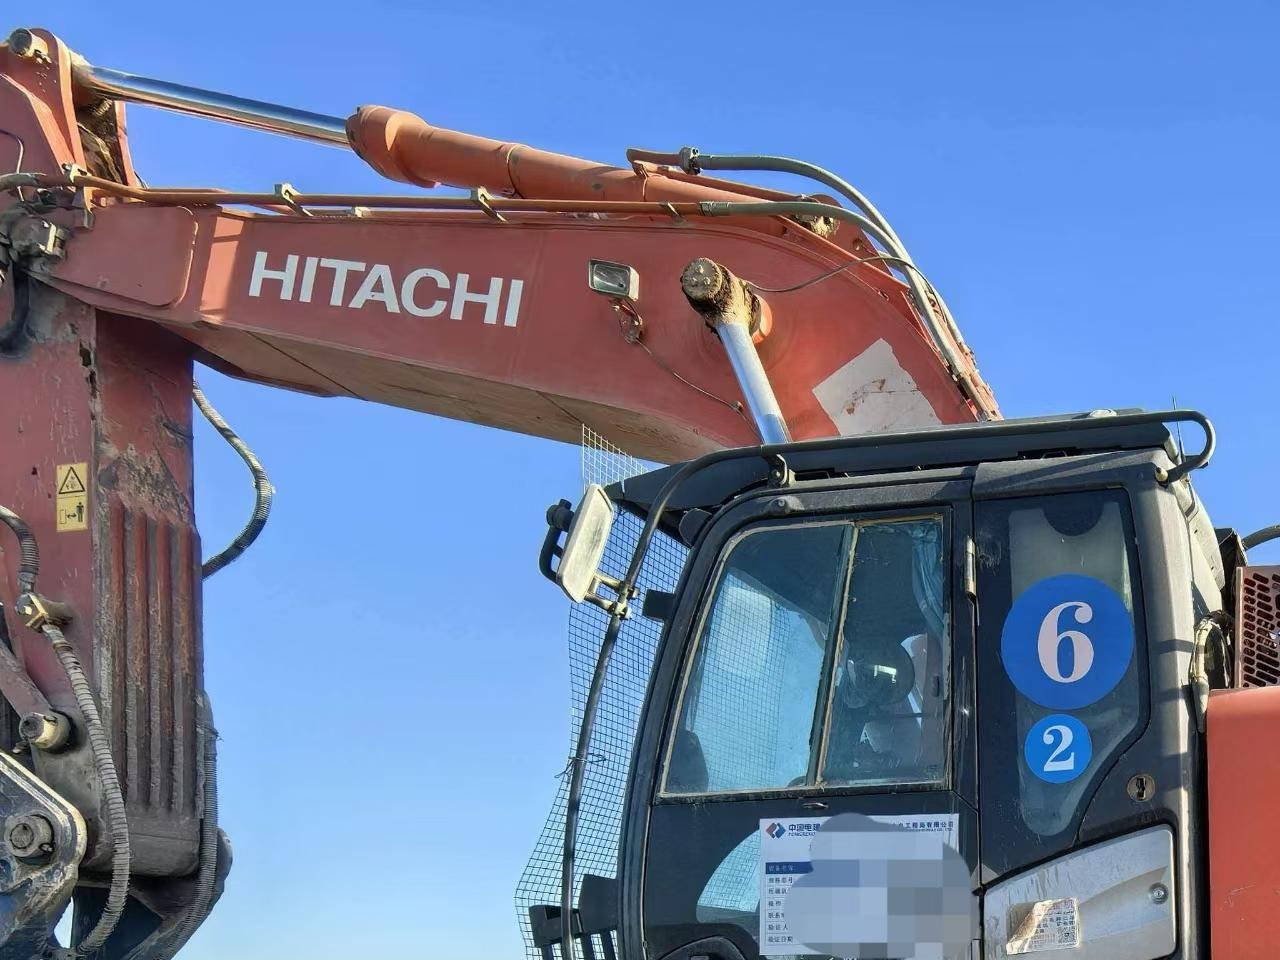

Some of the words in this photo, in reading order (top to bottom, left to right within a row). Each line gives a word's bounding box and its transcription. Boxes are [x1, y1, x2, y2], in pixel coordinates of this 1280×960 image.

[248, 251, 524, 328] HITACHI
[1037, 601, 1095, 683] 6
[1043, 724, 1075, 772] 2
